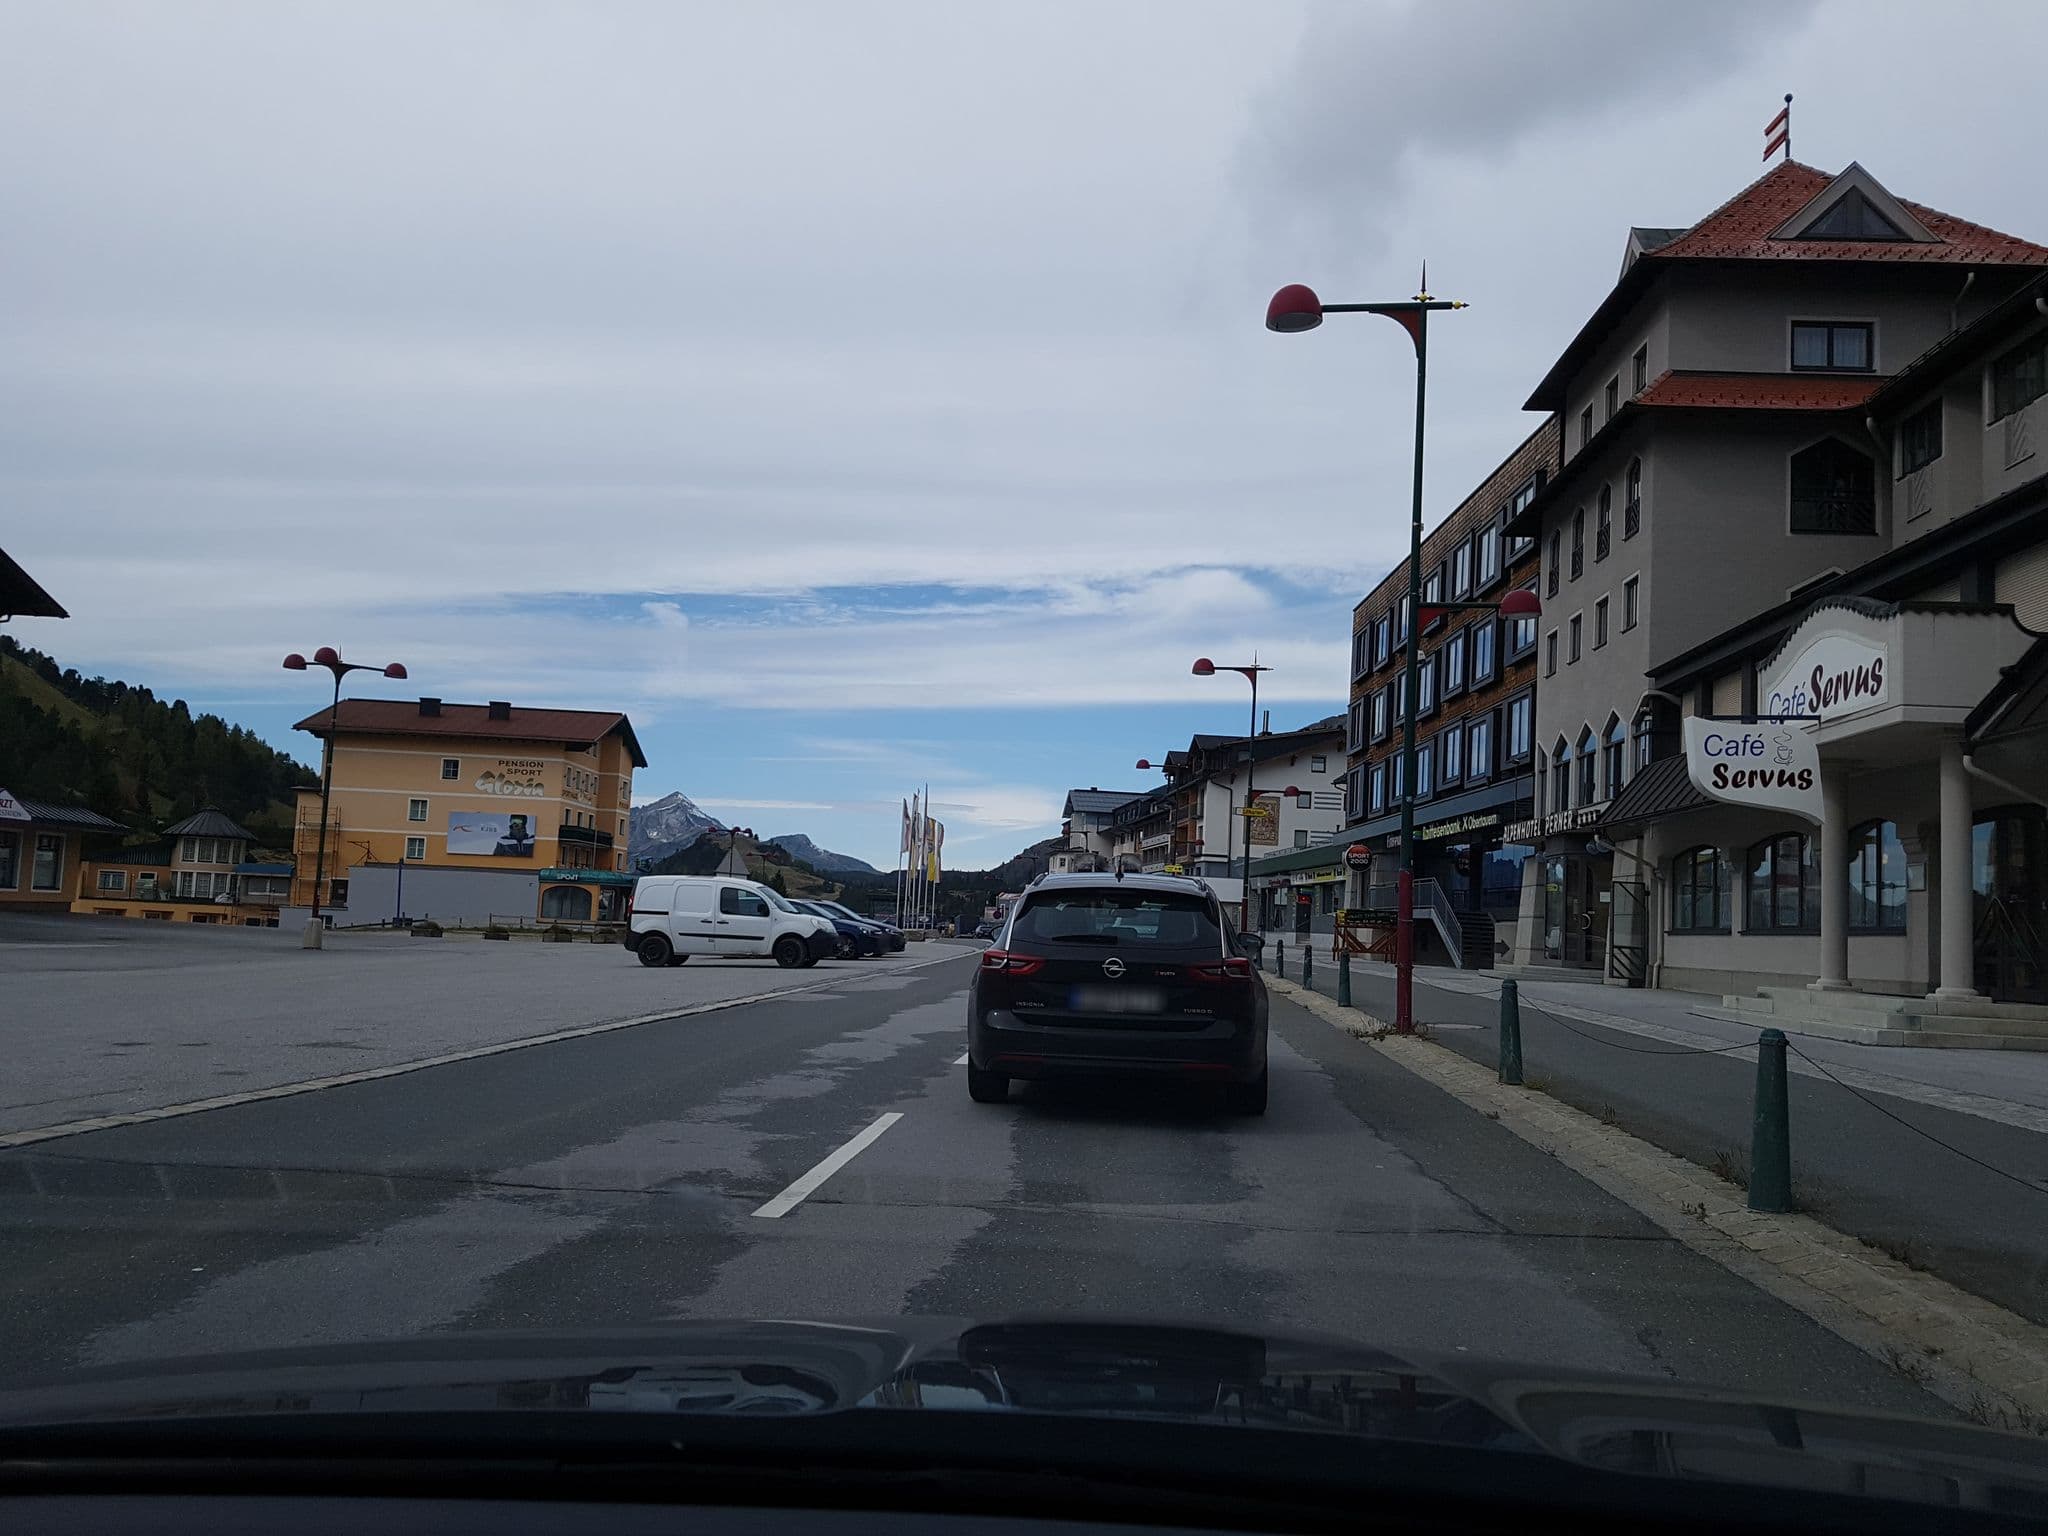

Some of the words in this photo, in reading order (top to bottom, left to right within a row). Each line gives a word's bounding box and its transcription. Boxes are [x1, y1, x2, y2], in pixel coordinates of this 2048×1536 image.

[1808, 657, 1883, 713] Servus
[1703, 733, 1766, 757] Café
[498, 760, 544, 768] PENSION
[506, 768, 542, 776] SPORT
[1712, 762, 1814, 790] Servus
[1503, 816, 1541, 843] ALPENHOTEL
[1545, 810, 1573, 836] PERNER
